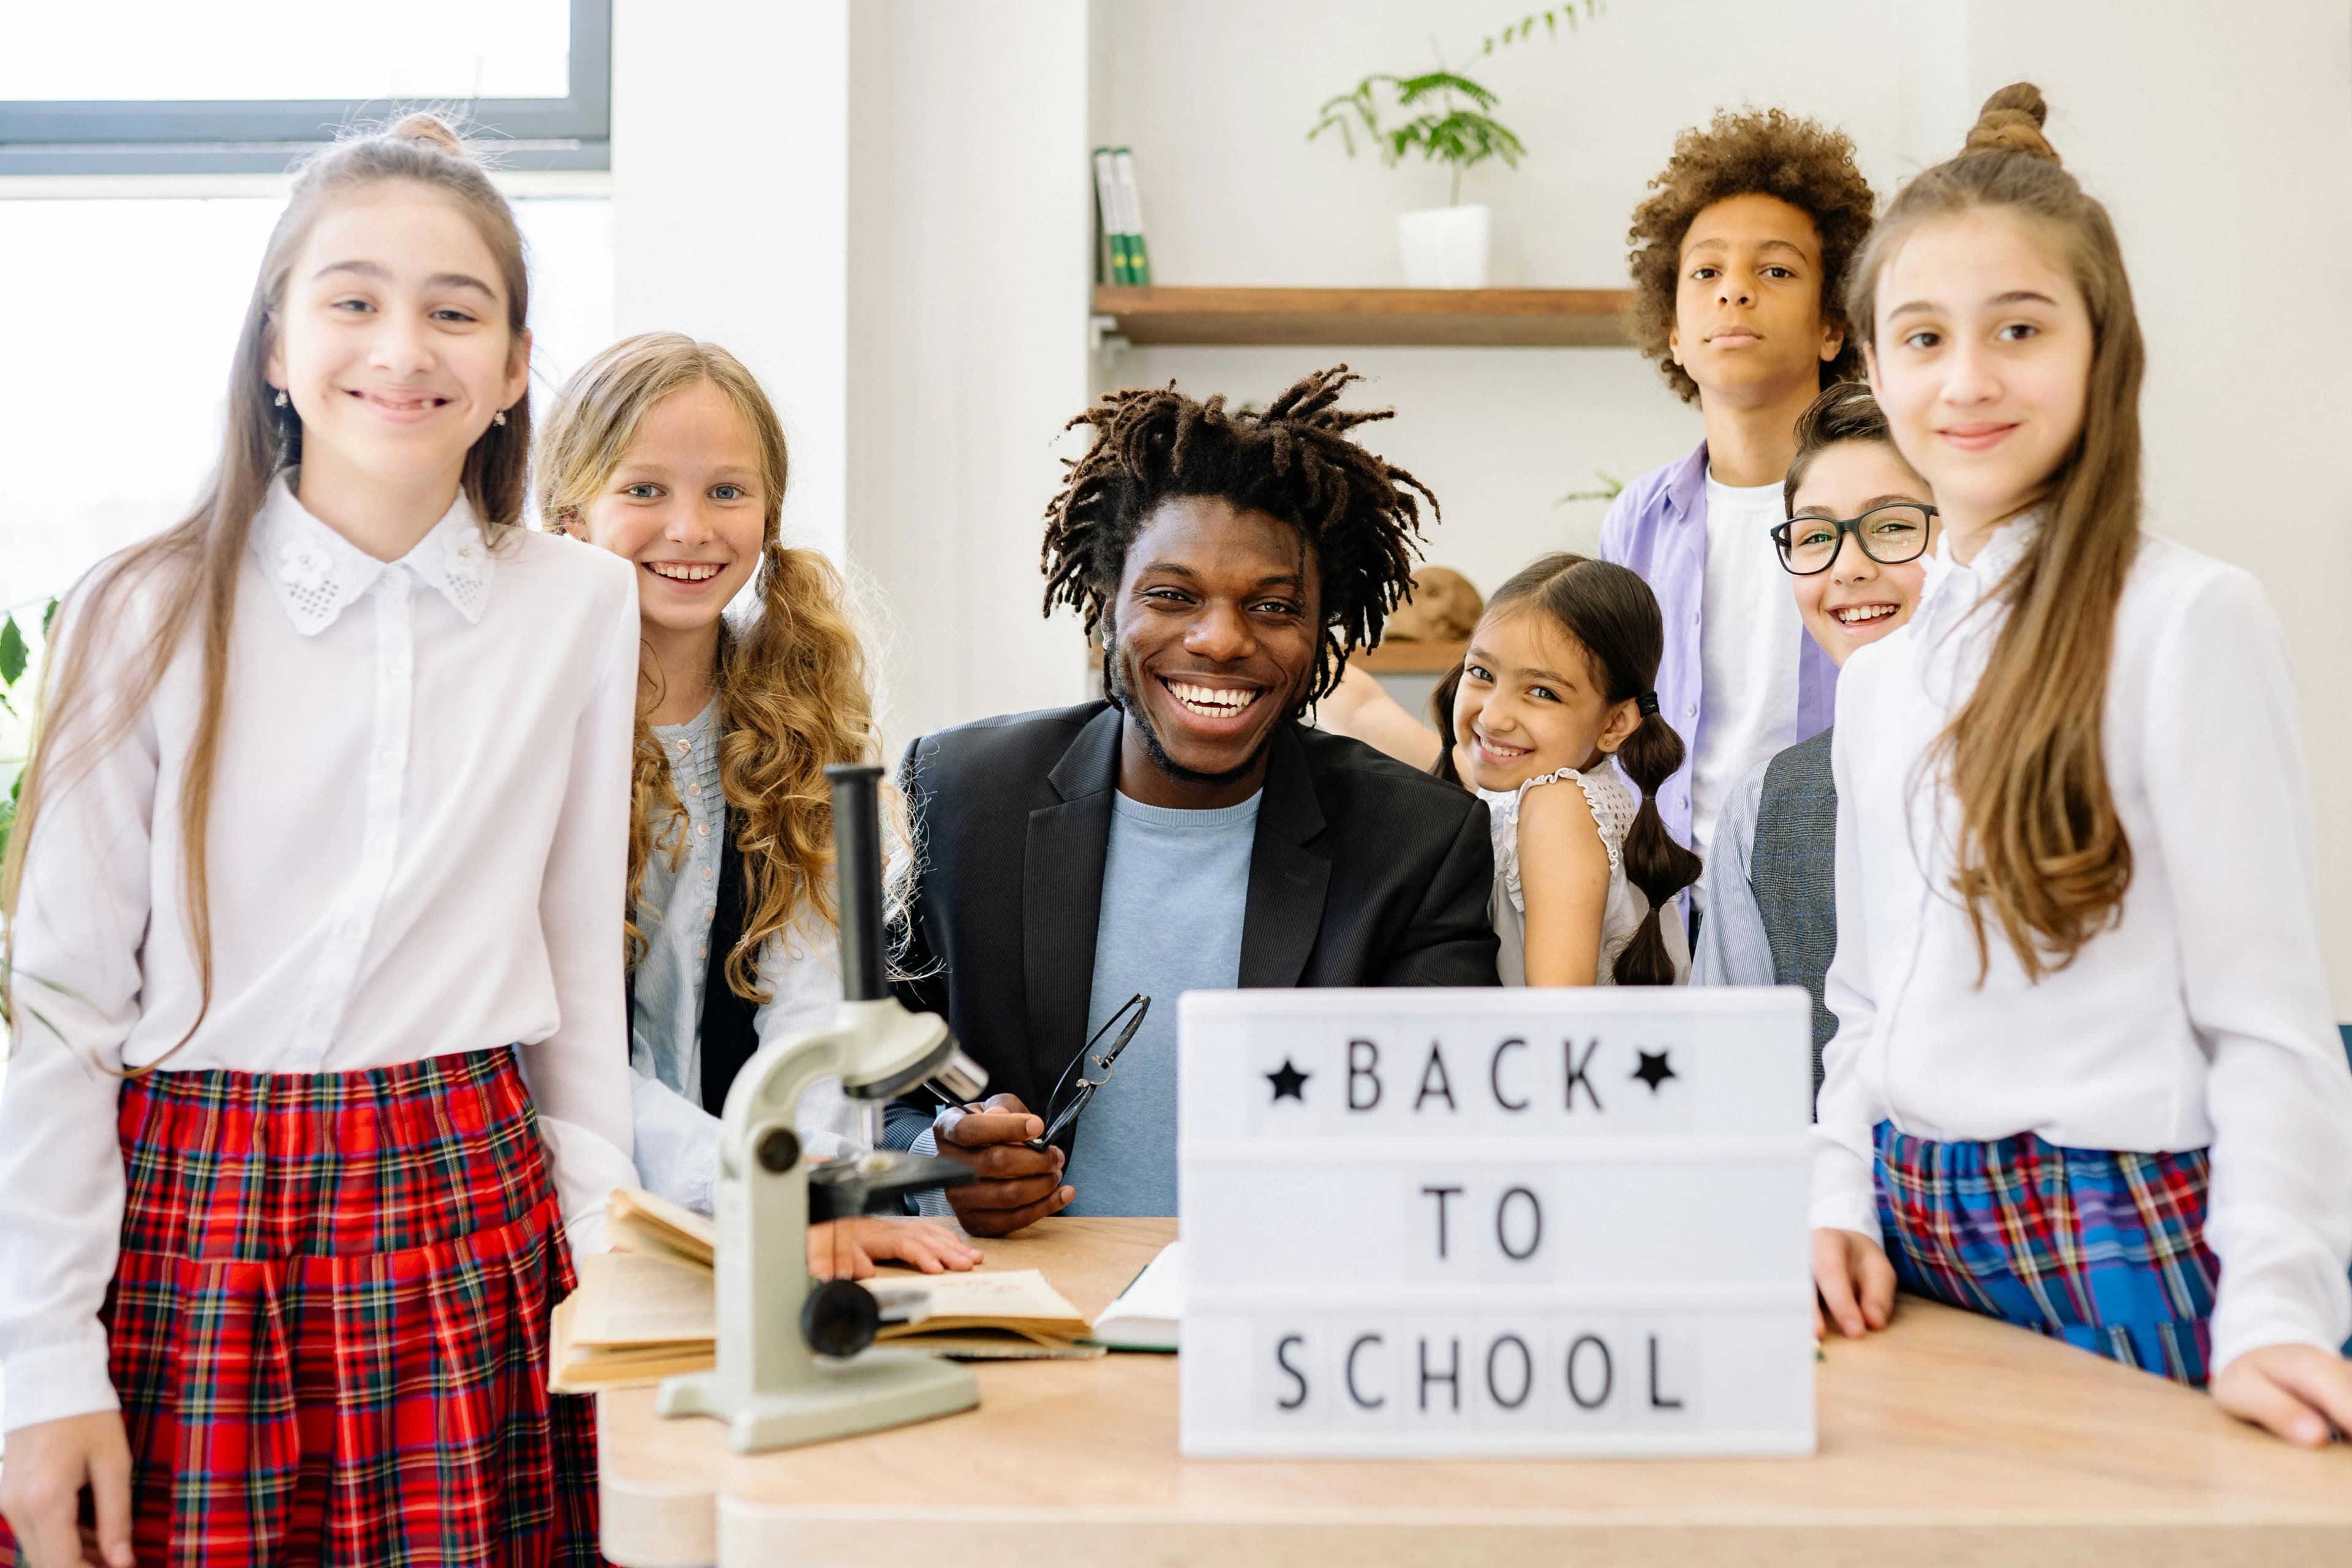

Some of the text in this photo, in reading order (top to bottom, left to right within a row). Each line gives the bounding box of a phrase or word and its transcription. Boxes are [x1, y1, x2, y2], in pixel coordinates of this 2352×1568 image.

[1348, 1038, 1606, 1112] BACK
[1422, 1186, 1543, 1261] TO
[1276, 1335, 1683, 1411] SCHOOL
